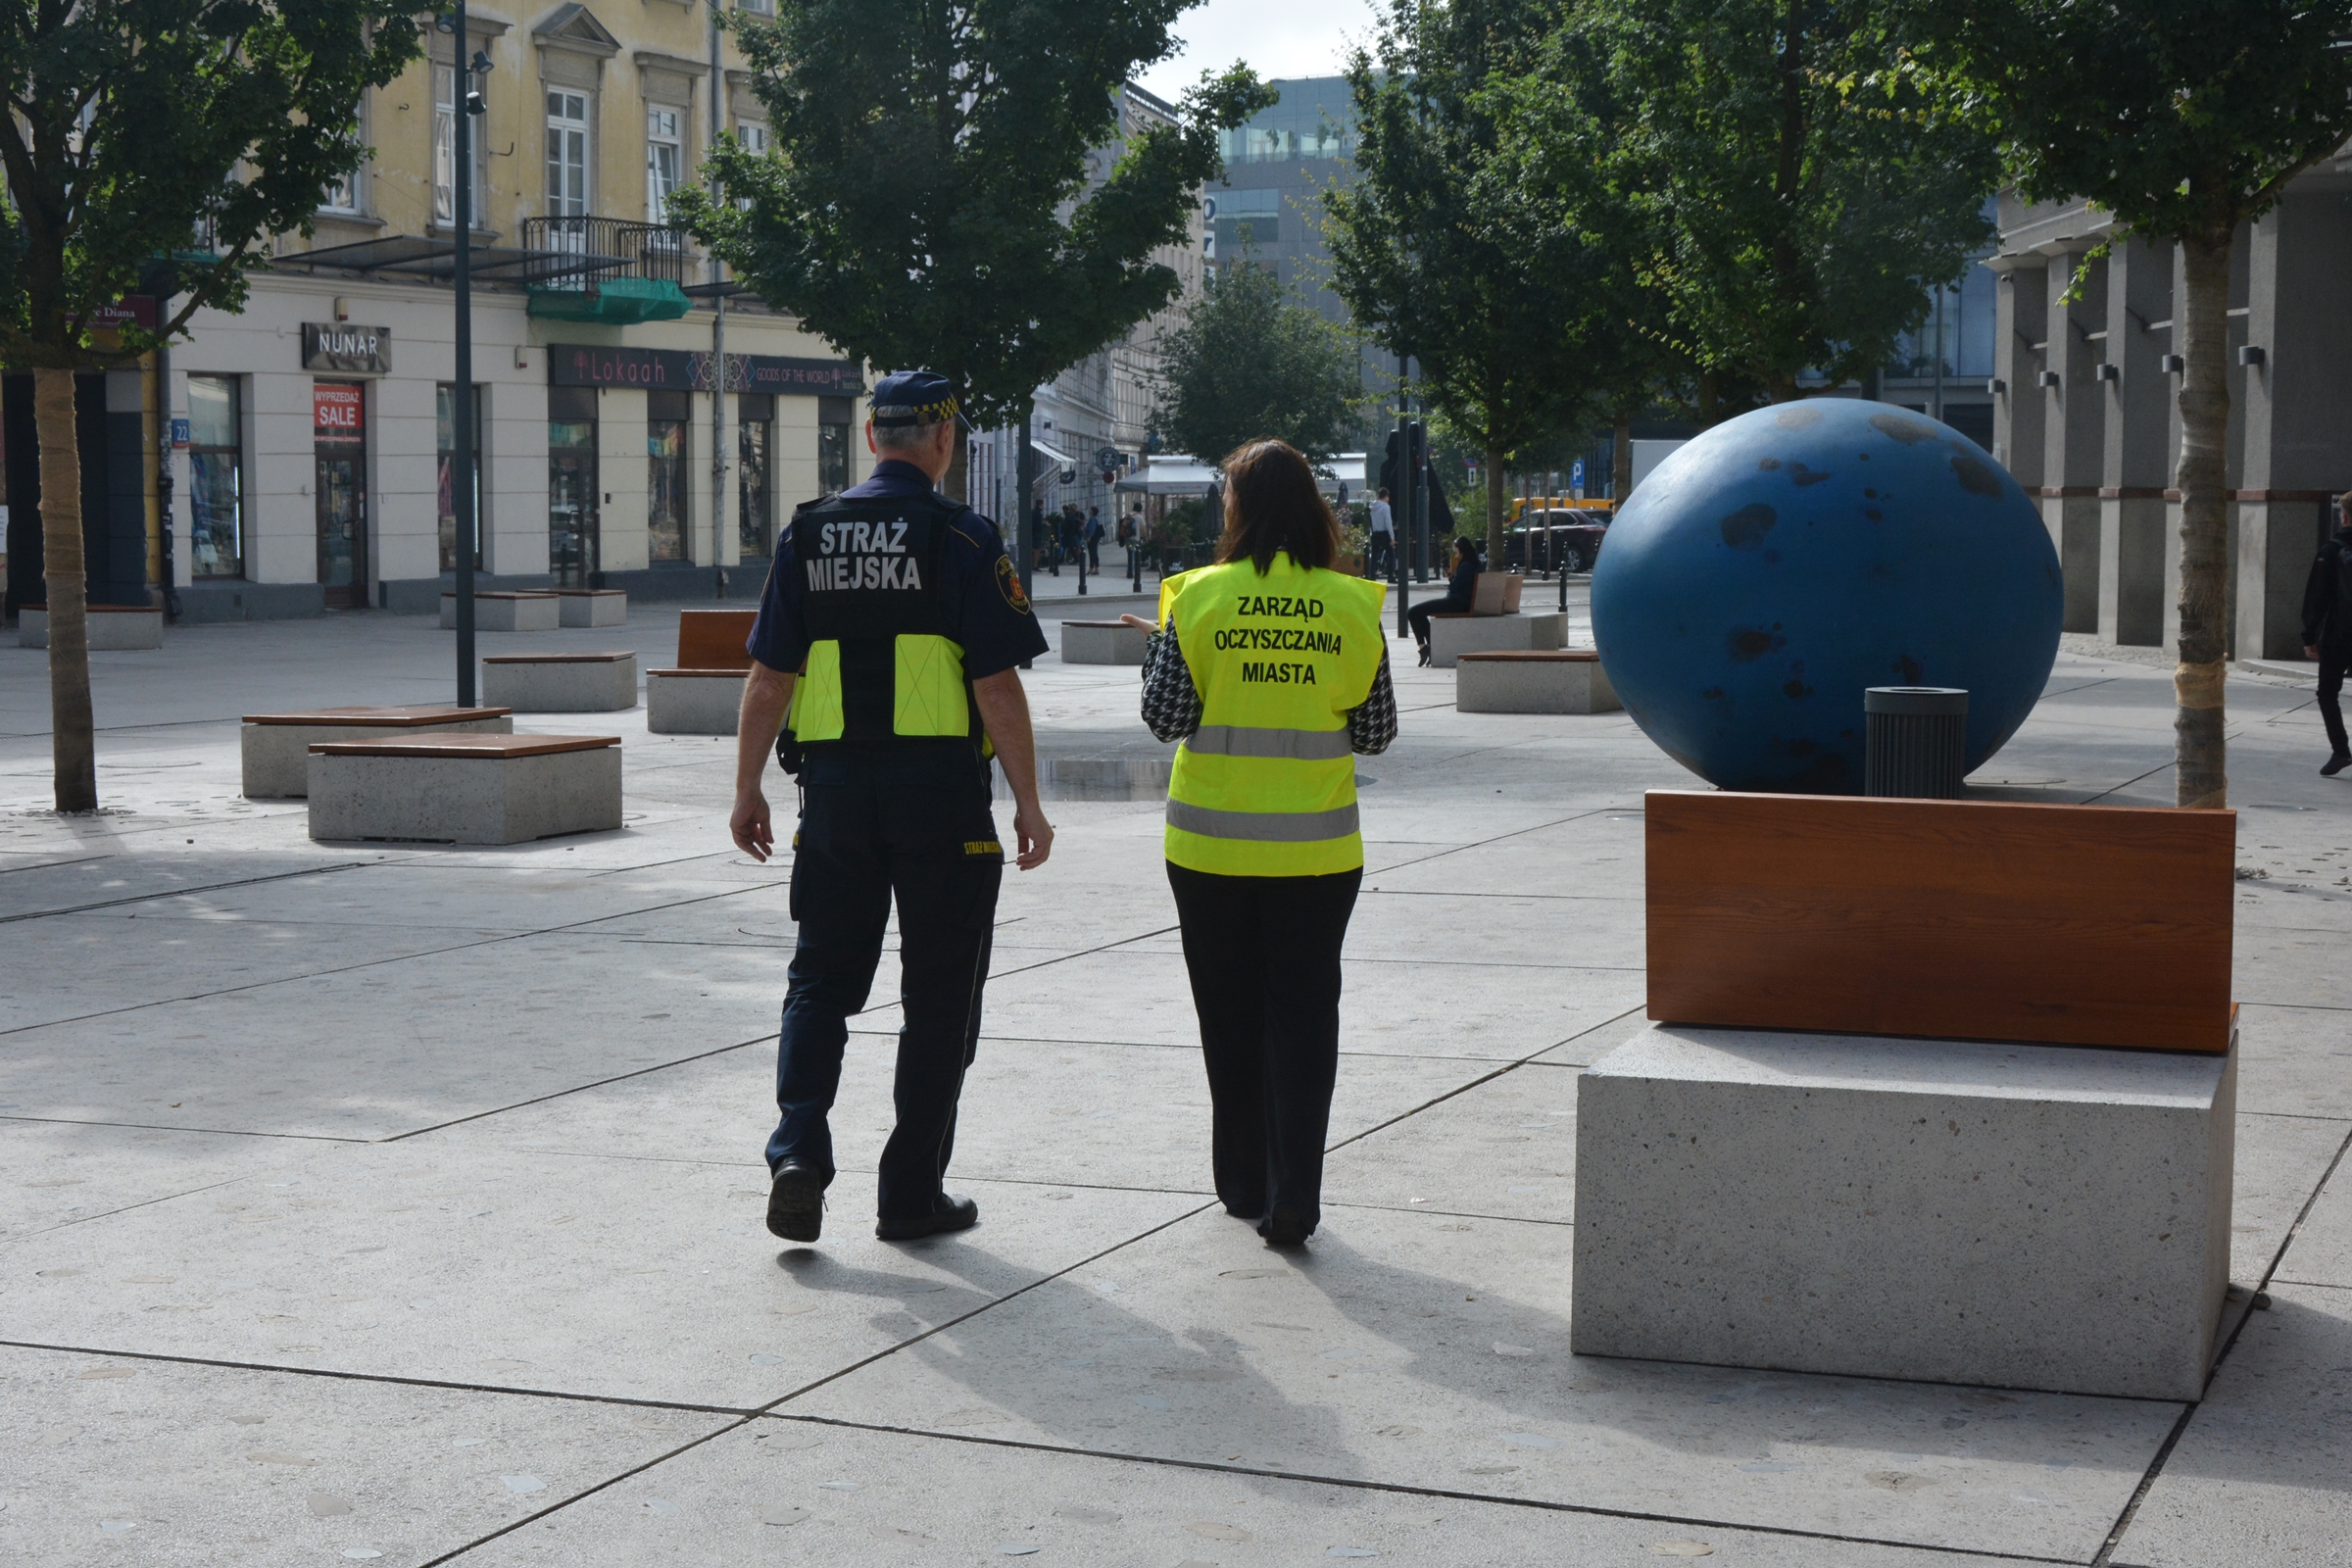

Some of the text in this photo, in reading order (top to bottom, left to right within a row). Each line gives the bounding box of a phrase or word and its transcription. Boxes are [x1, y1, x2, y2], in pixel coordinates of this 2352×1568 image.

[104, 307, 135, 318] Diana
[318, 332, 378, 355] NUNAR
[592, 352, 664, 383] Lokaah
[756, 367, 830, 384] GOODS OF THE WORLD
[315, 391, 360, 403] WYPRZEDAŻ
[319, 405, 356, 425] SALE
[176, 425, 188, 441] 22
[1573, 462, 1582, 481] P
[819, 516, 908, 555] STRAŻ
[806, 556, 922, 592] MIEJSKA
[1237, 596, 1324, 623] ZARZĄD
[1214, 628, 1342, 656] OCZYSZCZANIA
[1242, 662, 1316, 685] MIASTA
